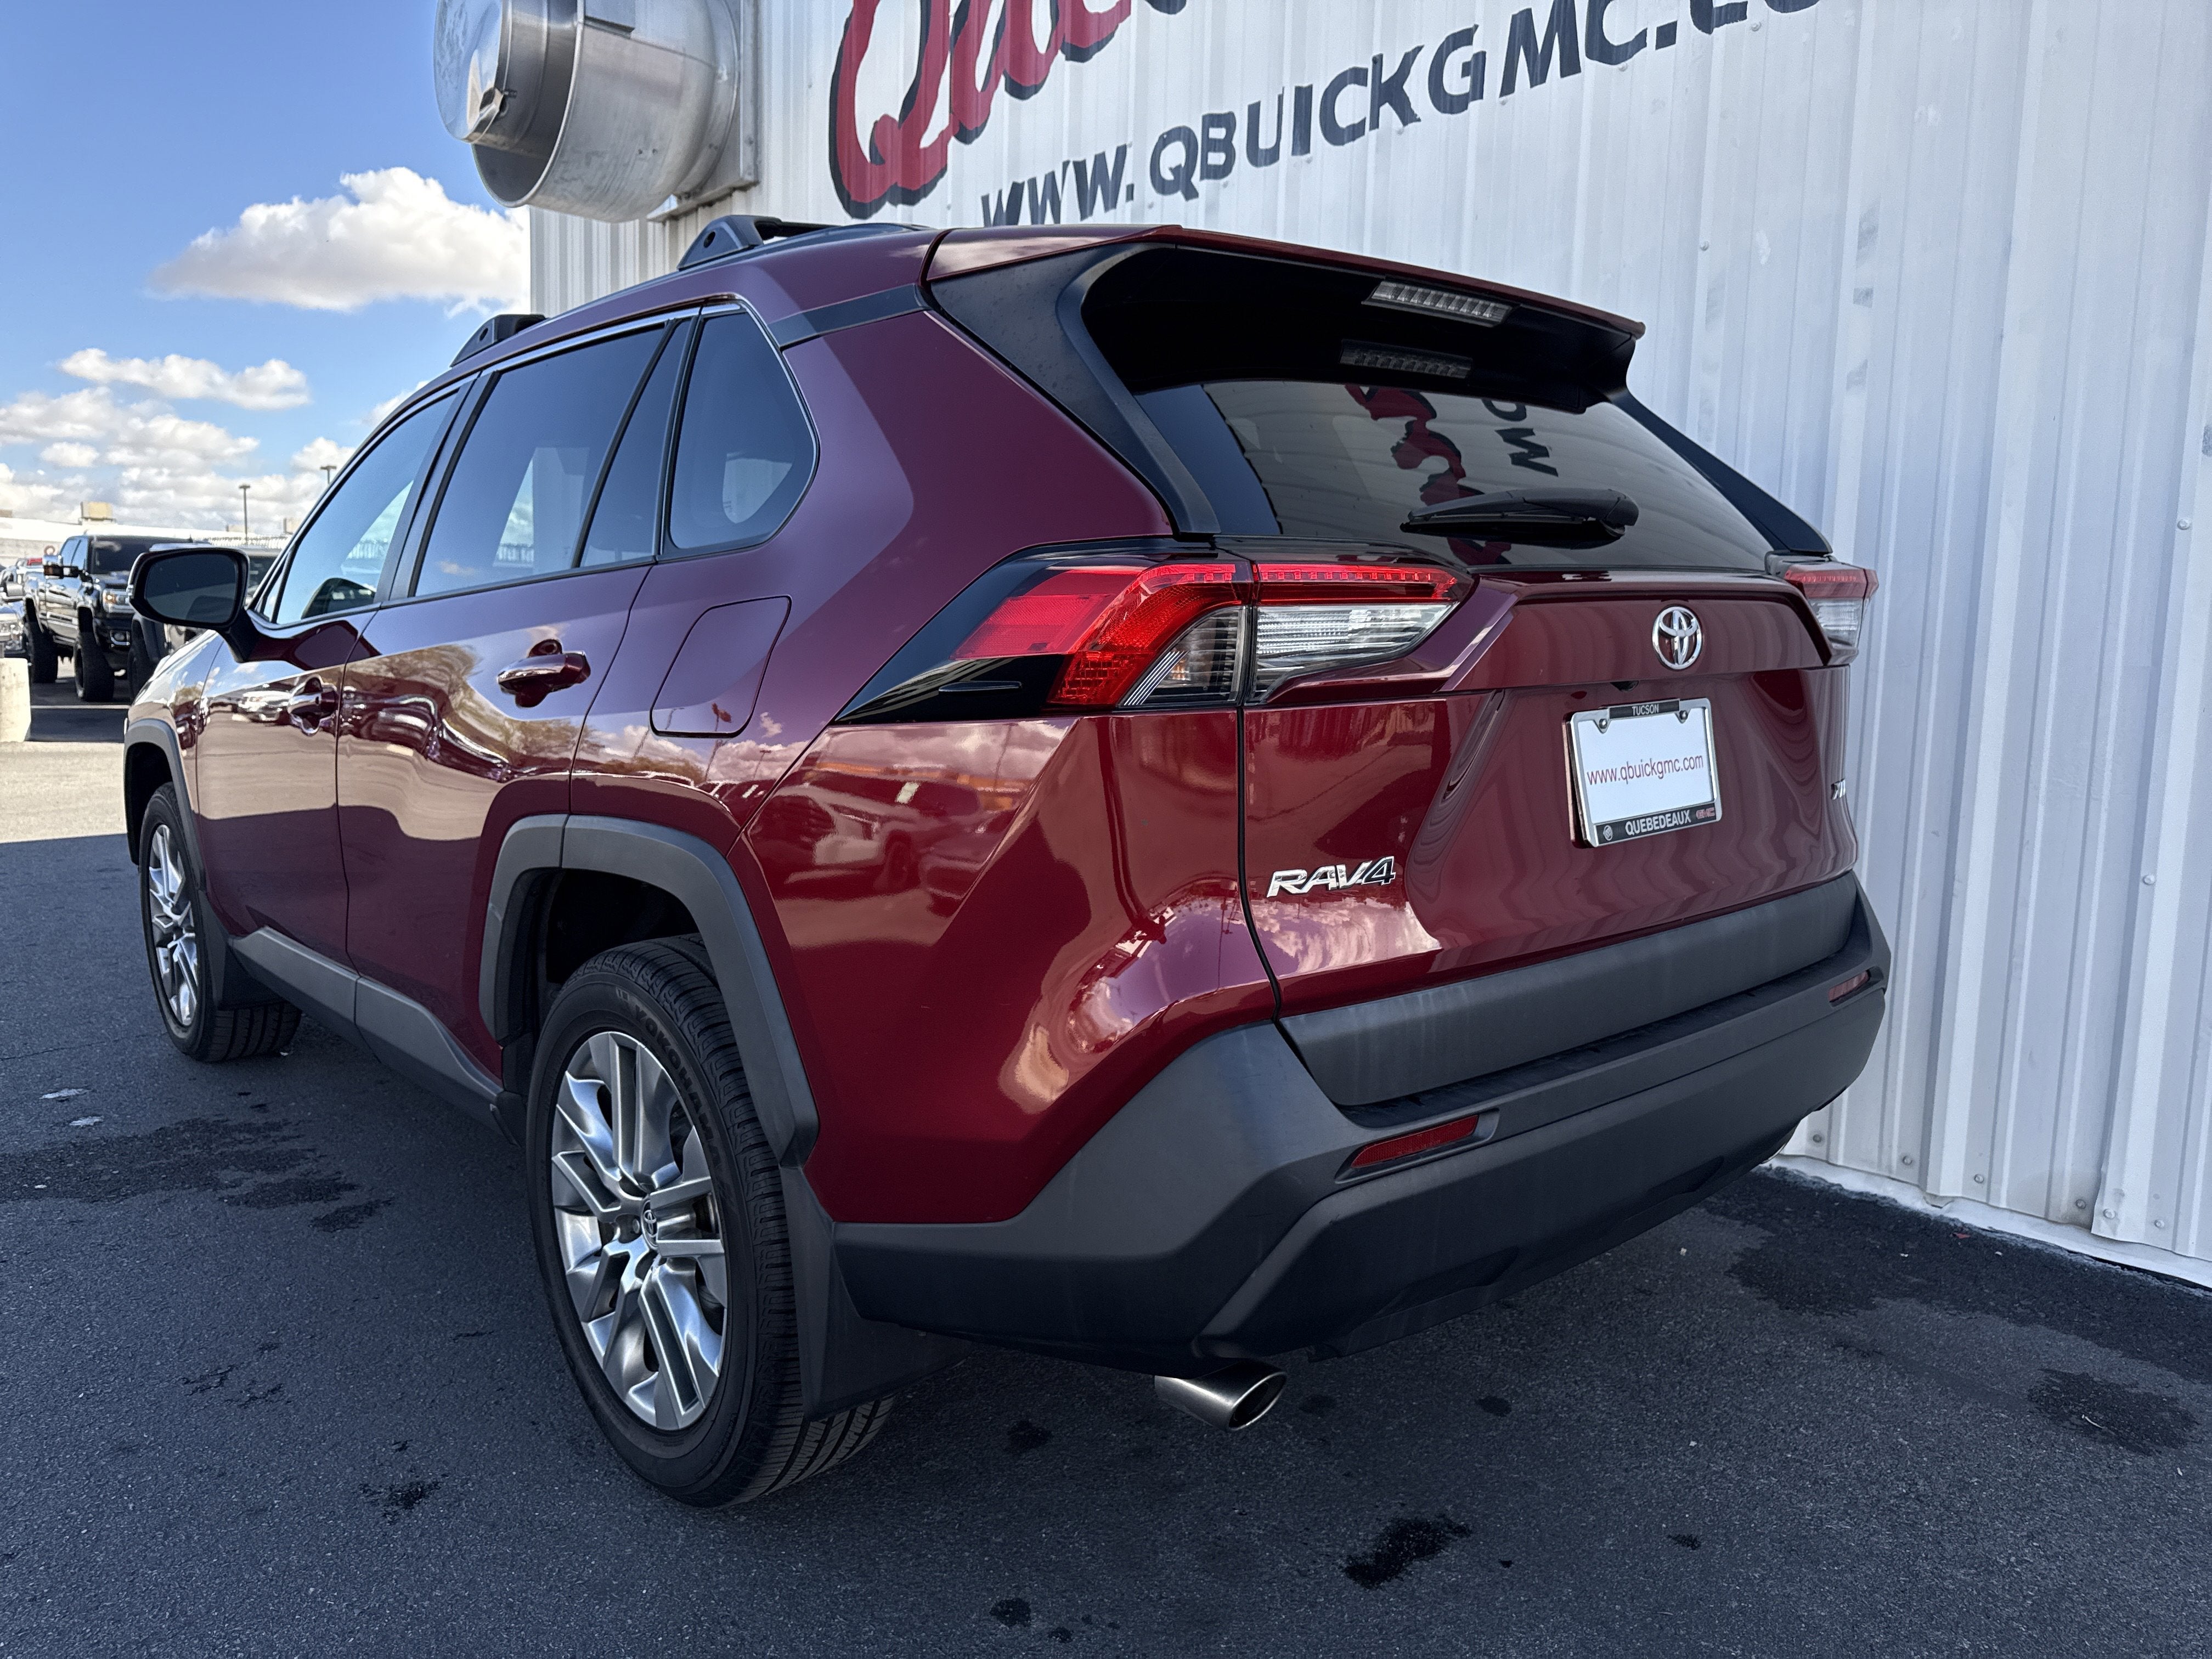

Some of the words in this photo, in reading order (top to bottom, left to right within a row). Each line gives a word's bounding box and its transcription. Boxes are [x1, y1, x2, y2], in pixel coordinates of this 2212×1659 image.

[1632, 704, 1660, 716] TUCSON
[1587, 755, 1704, 786] www.qbuickgmc.com
[1624, 810, 1692, 836] QUEBEDEAUX
[1266, 856, 1396, 898] RAV4
[634, 1005, 722, 1168] YOKOHAMA
